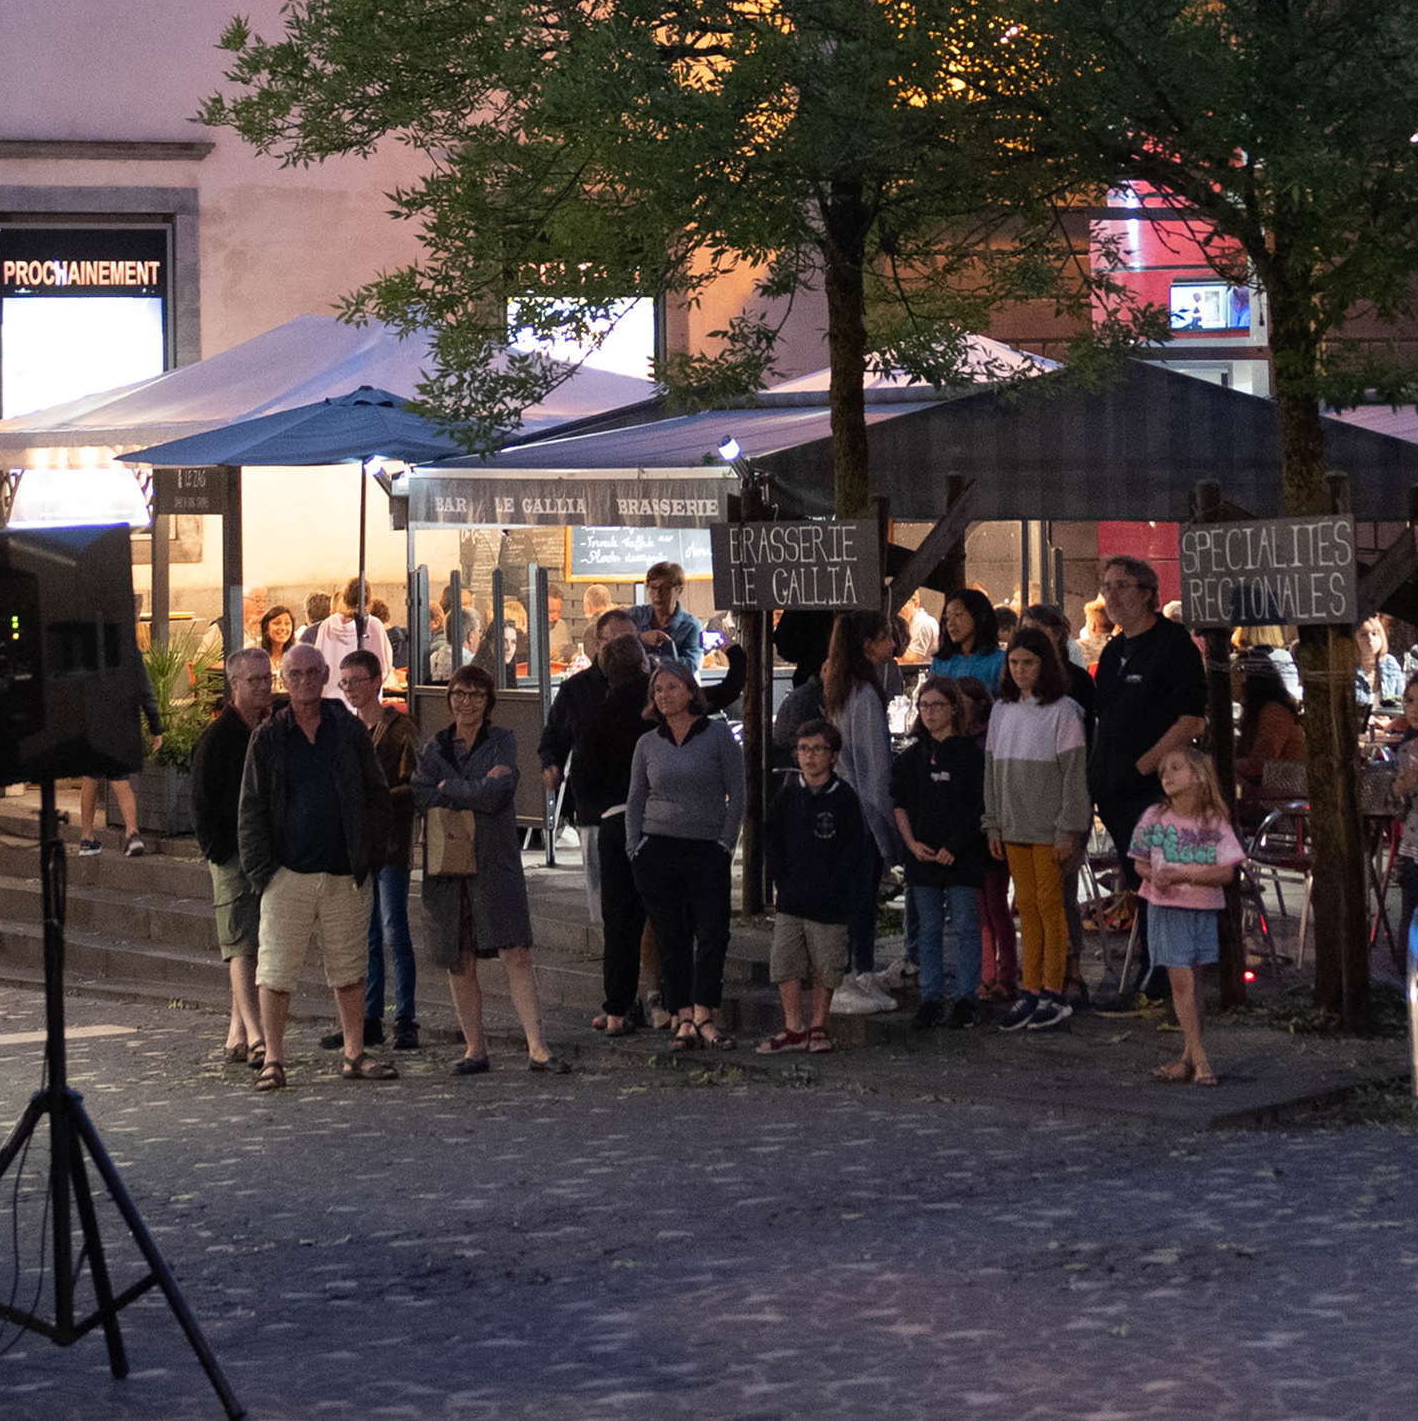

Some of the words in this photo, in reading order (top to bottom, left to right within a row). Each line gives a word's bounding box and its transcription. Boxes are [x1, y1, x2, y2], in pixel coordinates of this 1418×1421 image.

[3, 260, 160, 286] PROCHAINEMENT
[435, 496, 467, 513] BAR
[495, 497, 514, 514] LE
[522, 496, 587, 514] GALLIA
[616, 497, 719, 517] BRASSERIE
[730, 525, 857, 564] BRASSERIE
[731, 568, 757, 605] LE
[772, 565, 858, 605] GALLIA
